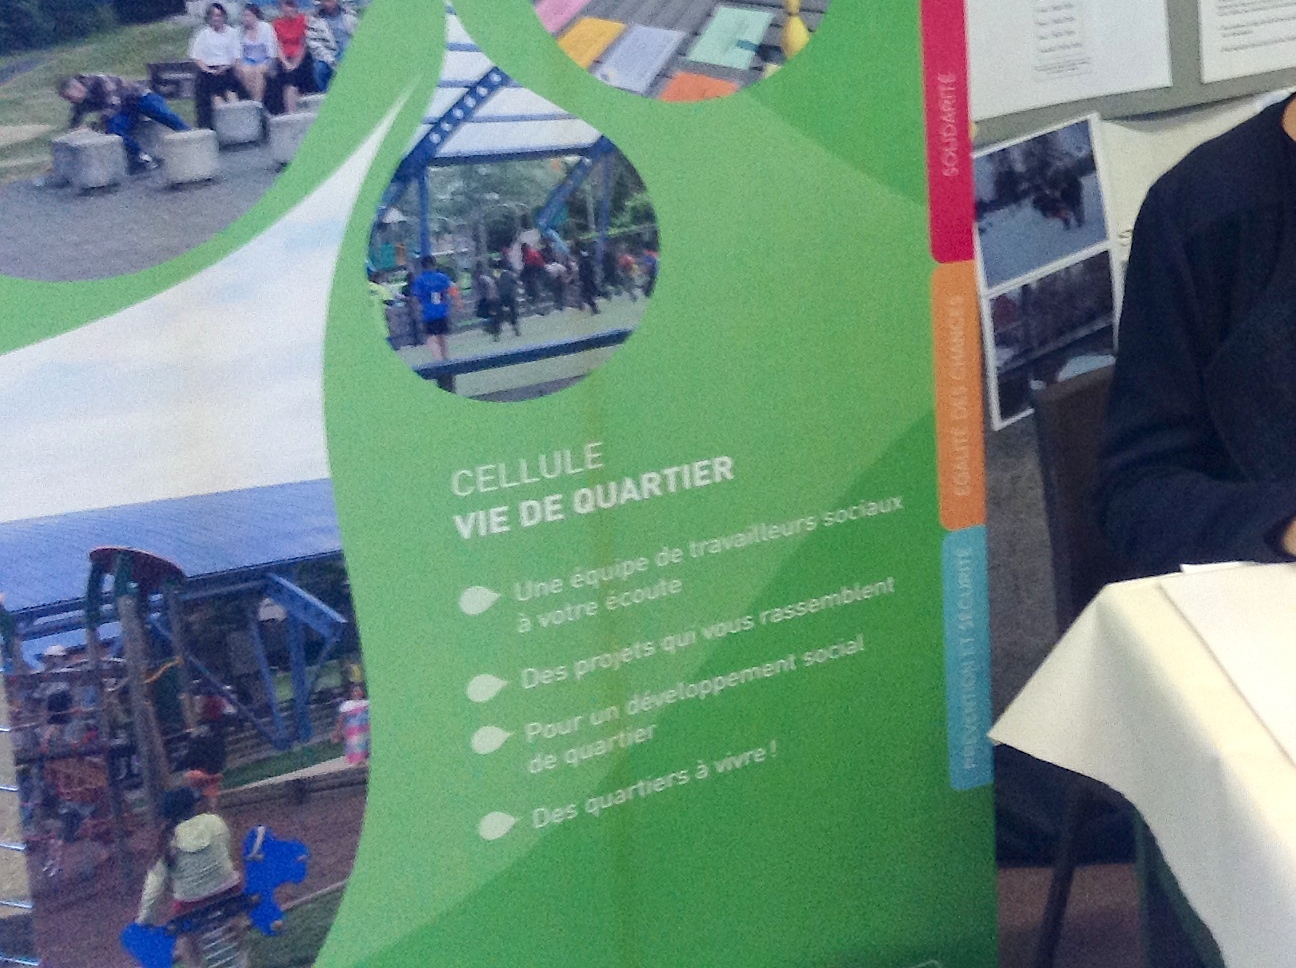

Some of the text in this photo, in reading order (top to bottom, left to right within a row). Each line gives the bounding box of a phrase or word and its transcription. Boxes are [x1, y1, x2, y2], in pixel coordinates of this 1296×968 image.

[450, 441, 605, 498] CELLULE
[452, 455, 735, 540] VIE DE QUARTIER
[514, 494, 904, 602] Une équipe de travailleurs sociaux
[517, 576, 684, 634] à votre écoute
[521, 576, 896, 690] Des projets qui vous rassemblent
[525, 634, 866, 743] Pour un développement social
[526, 722, 658, 775] de quartier
[531, 804, 579, 830] Des
[585, 769, 691, 817] quartiers
[694, 760, 710, 780] à
[715, 746, 768, 774] vivre
